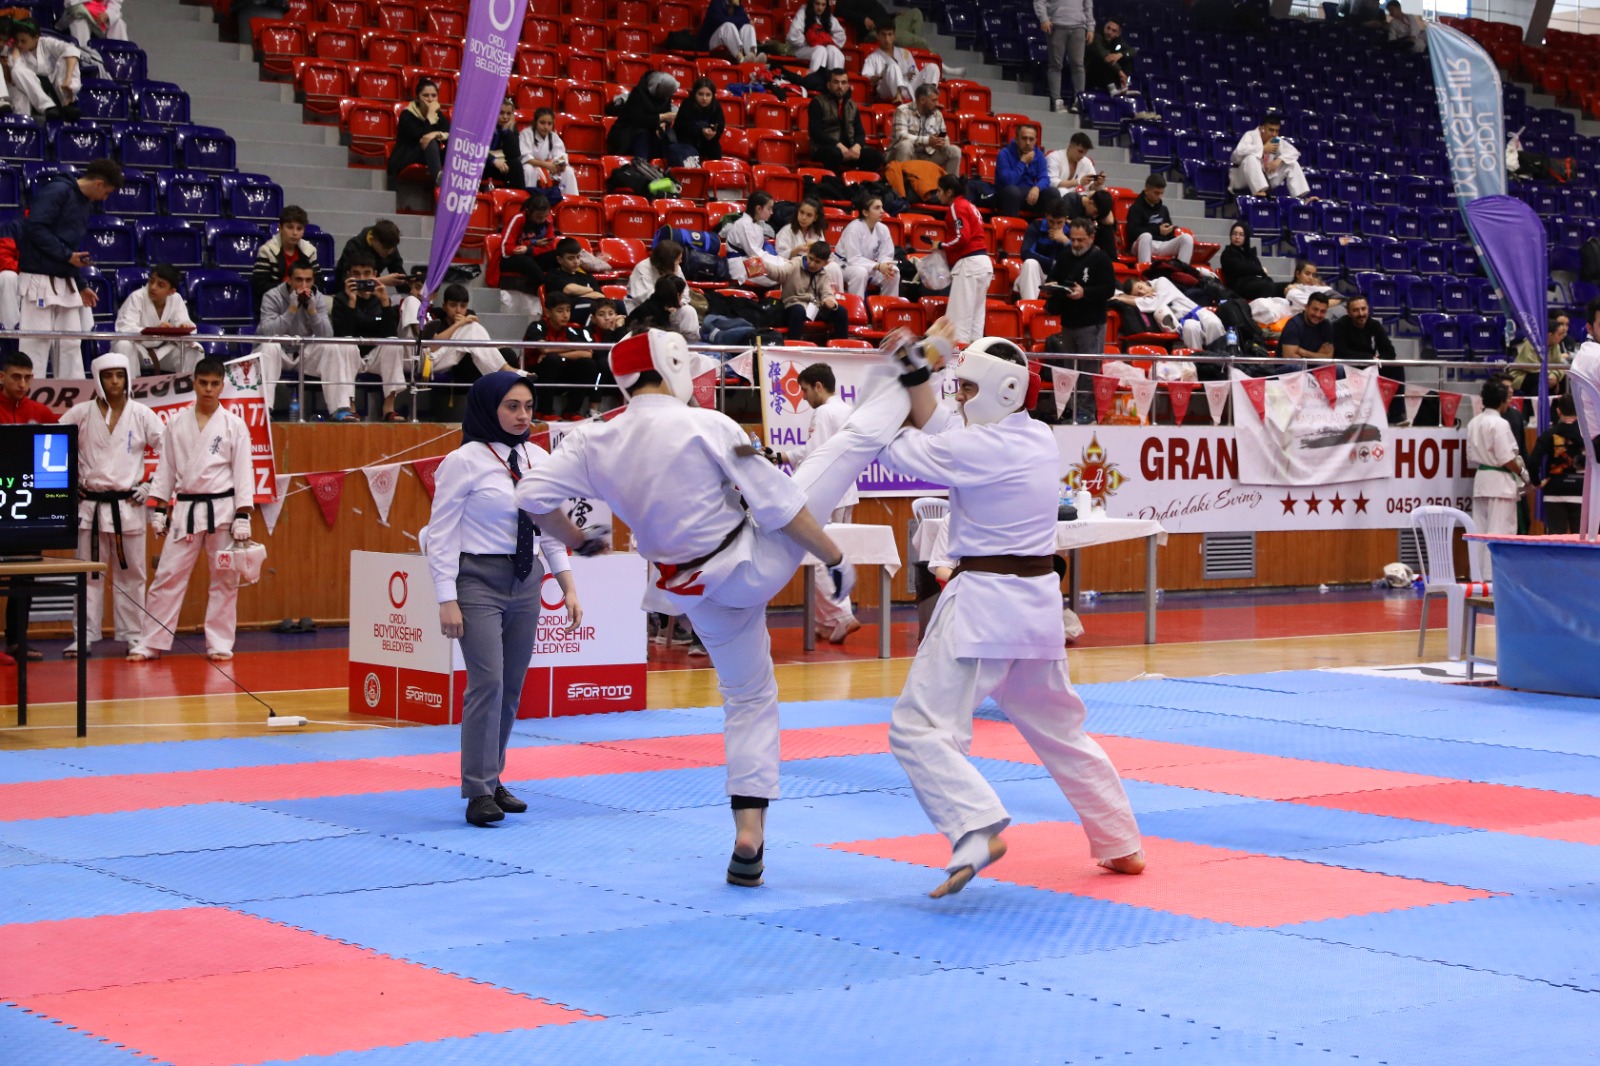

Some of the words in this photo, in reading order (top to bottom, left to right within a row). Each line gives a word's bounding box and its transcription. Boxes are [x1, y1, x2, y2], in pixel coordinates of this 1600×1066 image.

[488, 34, 506, 48] ORDU
[388, 614, 407, 625] ORDU
[538, 616, 568, 626] ORDU
